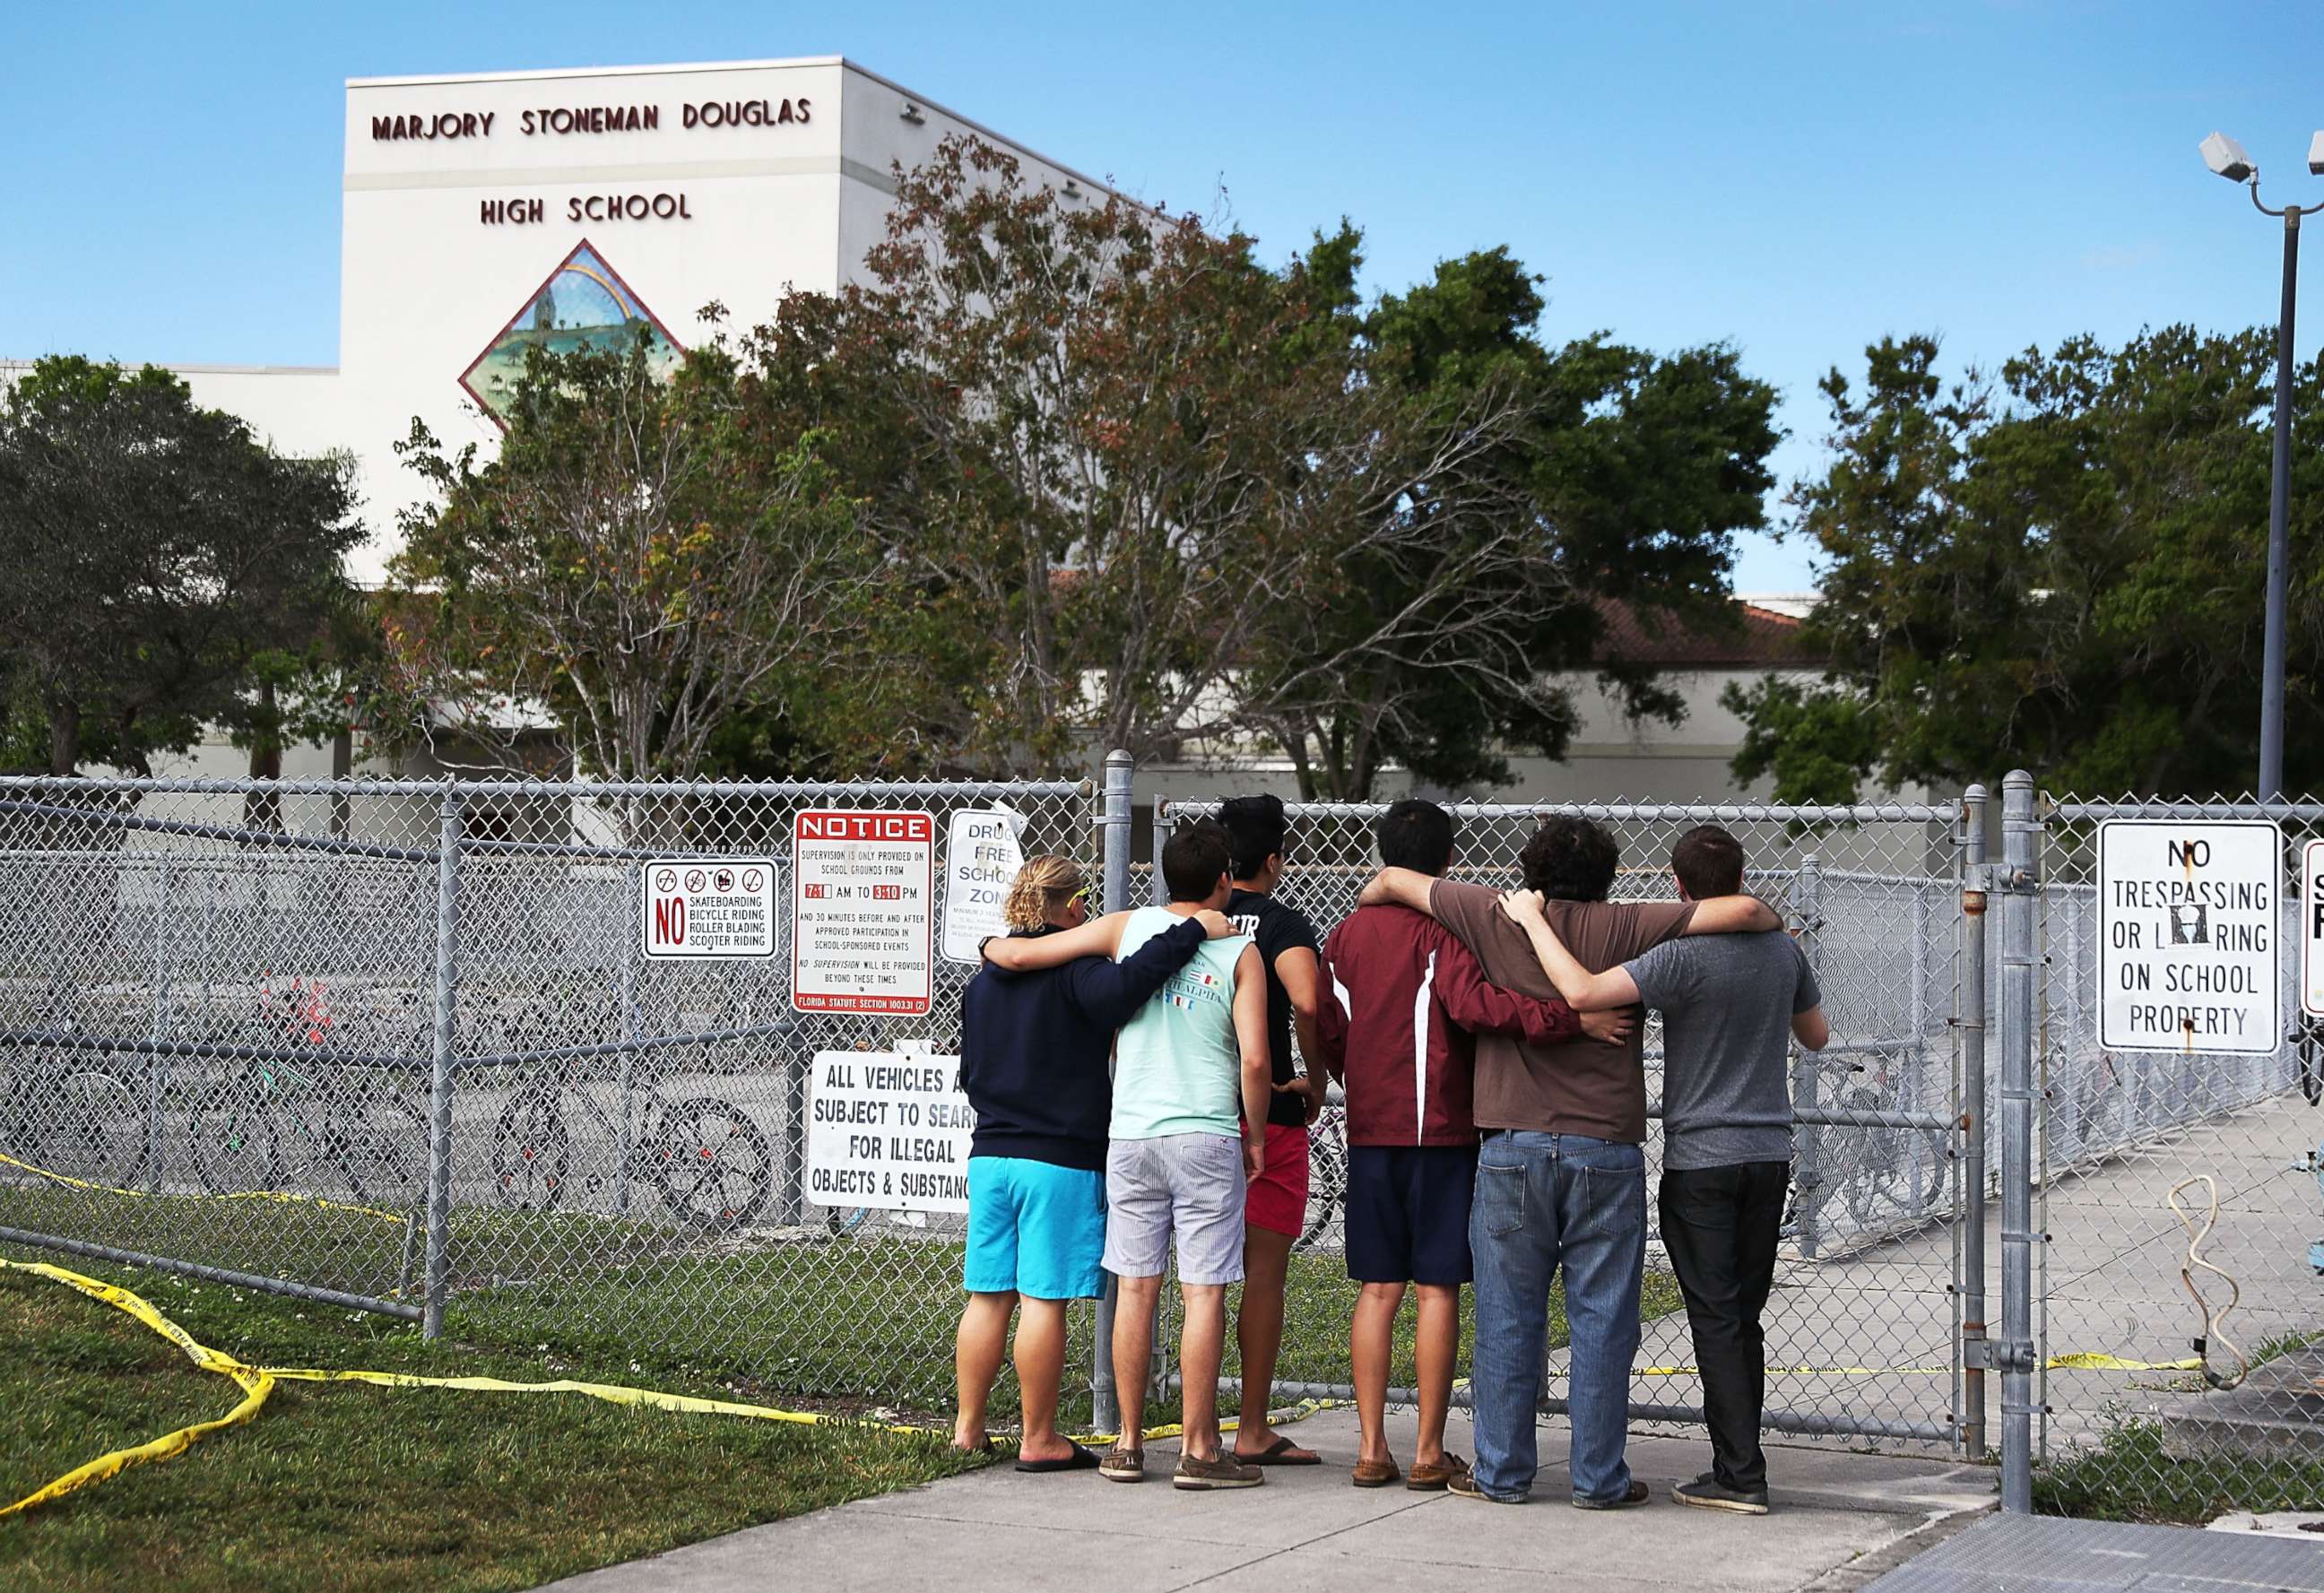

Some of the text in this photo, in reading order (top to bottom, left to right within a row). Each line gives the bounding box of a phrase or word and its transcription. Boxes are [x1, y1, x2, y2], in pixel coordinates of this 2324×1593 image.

[372, 98, 811, 141] MARJORY STONEMAN DOUGLAS
[481, 194, 691, 225] HIGH SCHOOL
[802, 817, 926, 838] NOTICE
[968, 825, 1011, 841] DRUG
[802, 850, 924, 861] SUPERVISION IS ONLY PROVIDED ON
[975, 846, 1013, 863] FREE
[2168, 839, 2211, 868] NO
[821, 864, 904, 876] SCHOOL GROUNDS FROM
[958, 866, 1014, 886] SCHOO
[689, 896, 762, 907] SKATEBOARDING
[837, 887, 851, 897] AM
[857, 887, 870, 898] TO
[903, 887, 917, 899] PM
[969, 888, 1005, 905] ZON
[2113, 880, 2268, 911] TRESPASSING
[655, 896, 685, 945] NO
[689, 909, 765, 921] BICYCLE RIDING
[800, 913, 925, 923] AND 30 MINUTES BEFORE AND AFTER
[689, 922, 766, 933] ROLLER BLADING
[815, 927, 909, 937] APPROVED PARTICIPATION IN
[689, 935, 766, 947] SCOOTER RIDING
[2112, 921, 2268, 952] OR LRING
[814, 941, 909, 951] SCHOOL-SPONSORED EVENTS
[799, 959, 925, 971] NO SUPERVISION WILL BE PROVIDED
[825, 974, 851, 983] BEYOND
[854, 974, 874, 983] THESE
[2121, 962, 2259, 993] ON SCHOOL
[798, 996, 925, 1010] FLORIDA STATUTE SECTION 1003.31 (2)
[2130, 1005, 2248, 1035] PROPERTY
[826, 1065, 854, 1088] ALL
[865, 1066, 943, 1093] VEHICLES
[814, 1098, 978, 1130] SUBJECT TO SEAR
[849, 1135, 955, 1164] FOR ILLEGAL
[812, 1167, 875, 1195] OBJECTS
[883, 1172, 892, 1196] &
